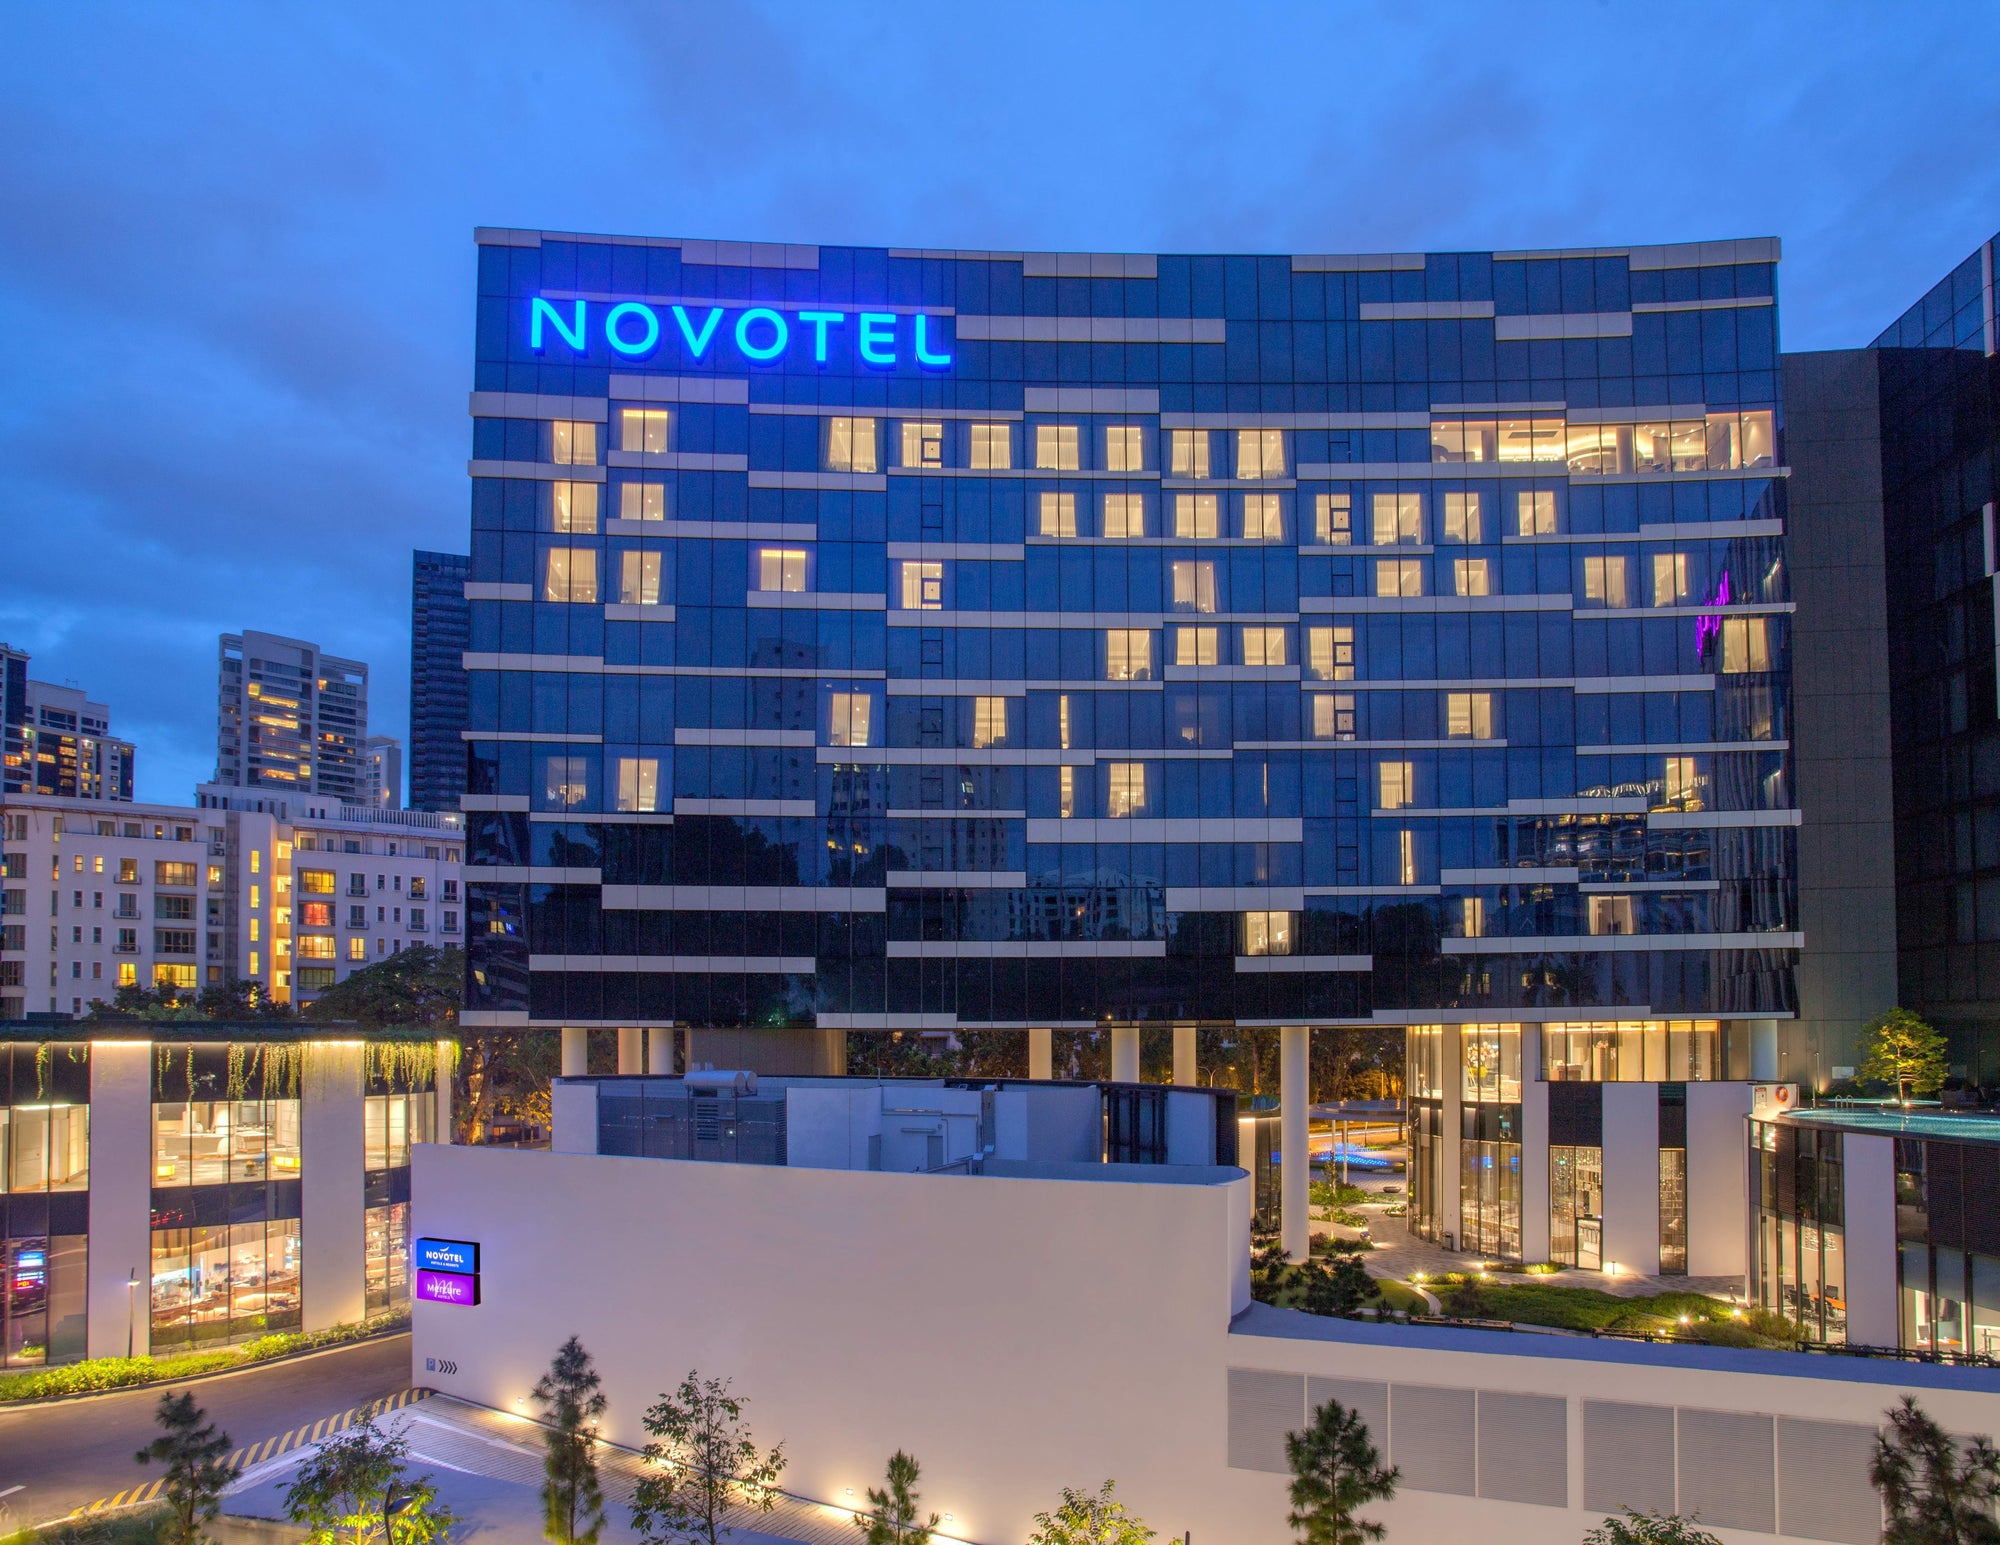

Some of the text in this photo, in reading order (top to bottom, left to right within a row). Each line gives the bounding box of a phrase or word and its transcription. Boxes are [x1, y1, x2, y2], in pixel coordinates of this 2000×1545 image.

[530, 297, 951, 365] NOVOTEL
[426, 1251, 464, 1263] NOVOTEL
[427, 1283, 461, 1296] Mercure
